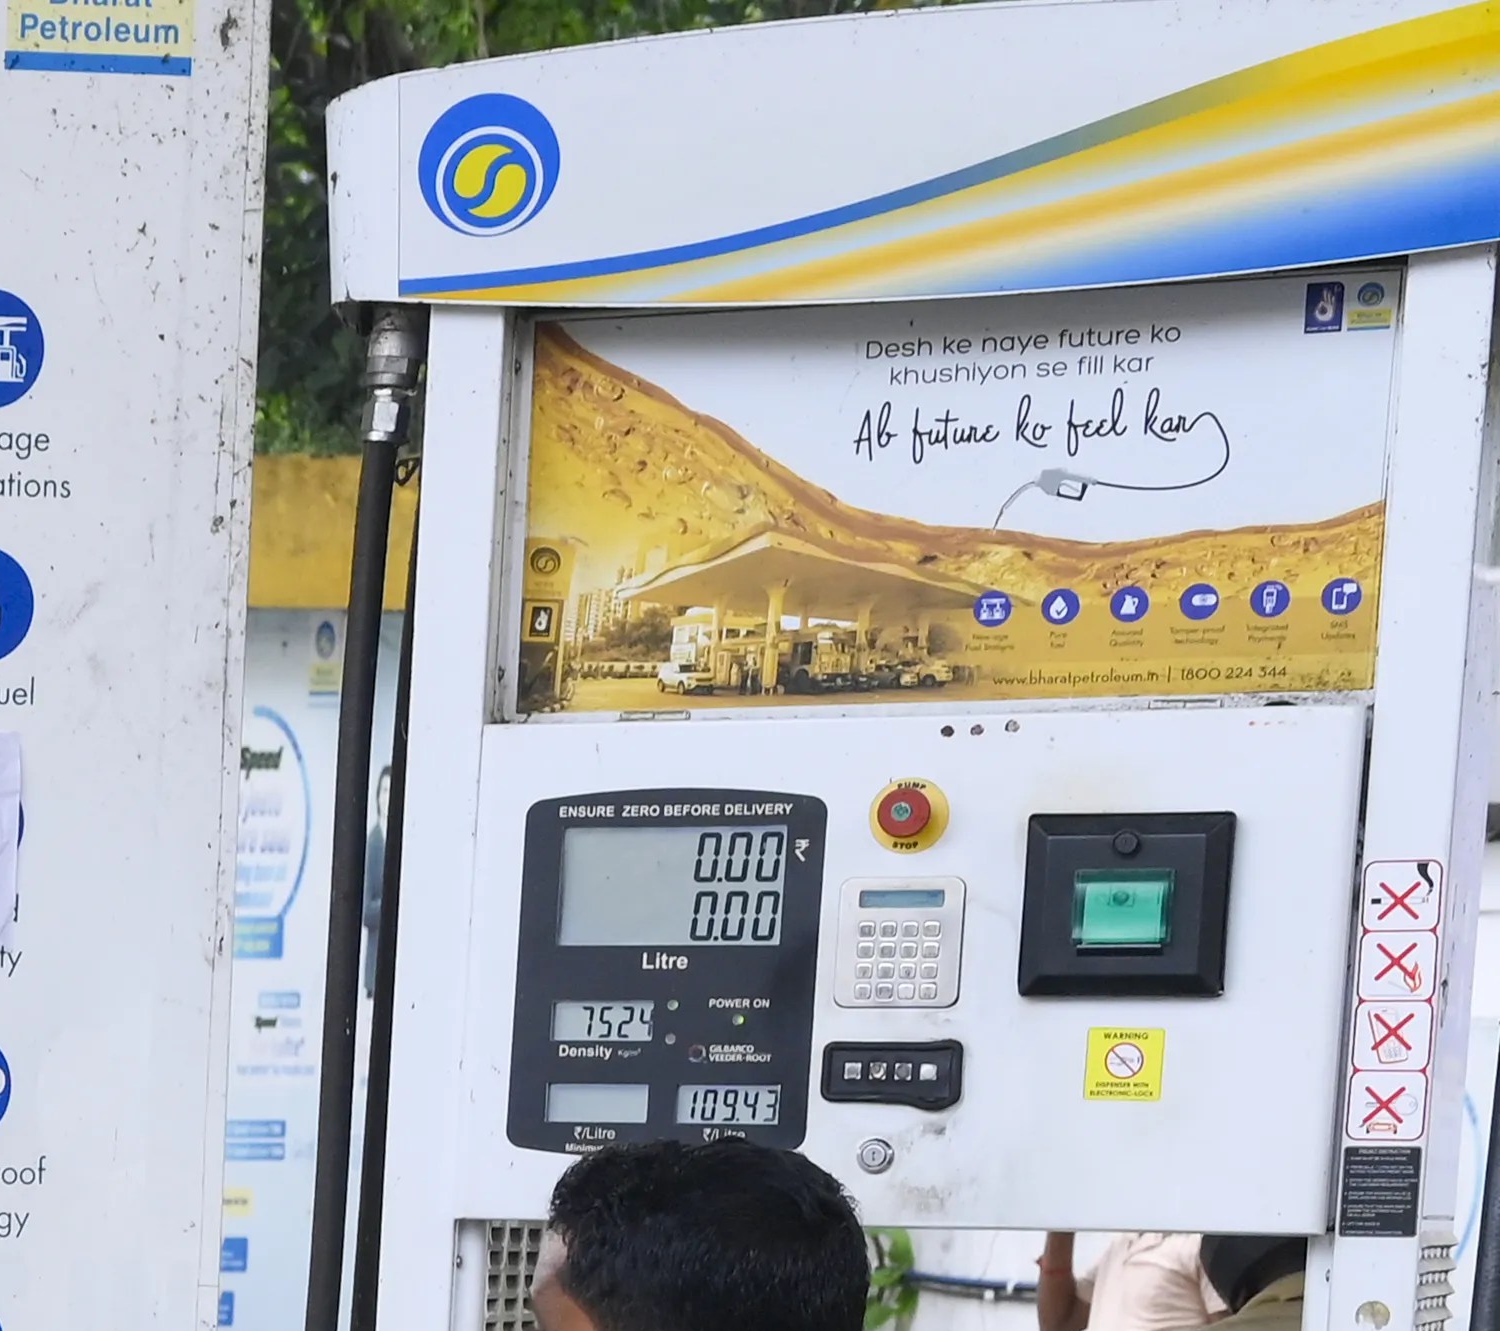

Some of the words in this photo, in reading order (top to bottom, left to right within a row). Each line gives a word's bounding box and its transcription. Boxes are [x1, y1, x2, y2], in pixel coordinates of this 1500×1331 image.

[19, 13, 180, 45] Petroleum
[865, 337, 933, 360] Desh
[942, 334, 973, 356] ke
[981, 331, 1050, 355] naye
[1058, 325, 1141, 349] future
[1150, 323, 1182, 344] ko
[888, 361, 1028, 387] khushiyon
[1035, 360, 1068, 378] se
[1076, 355, 1104, 376] fill
[1112, 353, 1156, 374] kar
[853, 401, 898, 462] Ab
[911, 407, 1001, 464] future
[1015, 393, 1053, 448] ko
[1066, 387, 1128, 457] feel
[1142, 386, 1208, 442] kar
[1180, 666, 1222, 681] 1800
[1224, 666, 1254, 679] 224
[897, 781, 927, 790] PUMP
[558, 805, 615, 819] ENSURE
[621, 804, 661, 818] ZERO
[663, 803, 721, 818] BEFORE
[724, 802, 794, 817] DELIVERY
[891, 840, 920, 850] STOP
[693, 831, 785, 883] 0.00
[689, 890, 781, 942] 0.00
[641, 951, 690, 971] Litre
[708, 997, 751, 1009] POWER
[752, 997, 771, 1009] ON
[1103, 1031, 1149, 1040] WARNING
[558, 1043, 613, 1061] Density
[708, 1043, 755, 1054] GILBARCO
[708, 1053, 772, 1063] VEEDER-ROOT
[688, 1088, 780, 1123] 109.43
[572, 1125, 616, 1141] ₹/Litre
